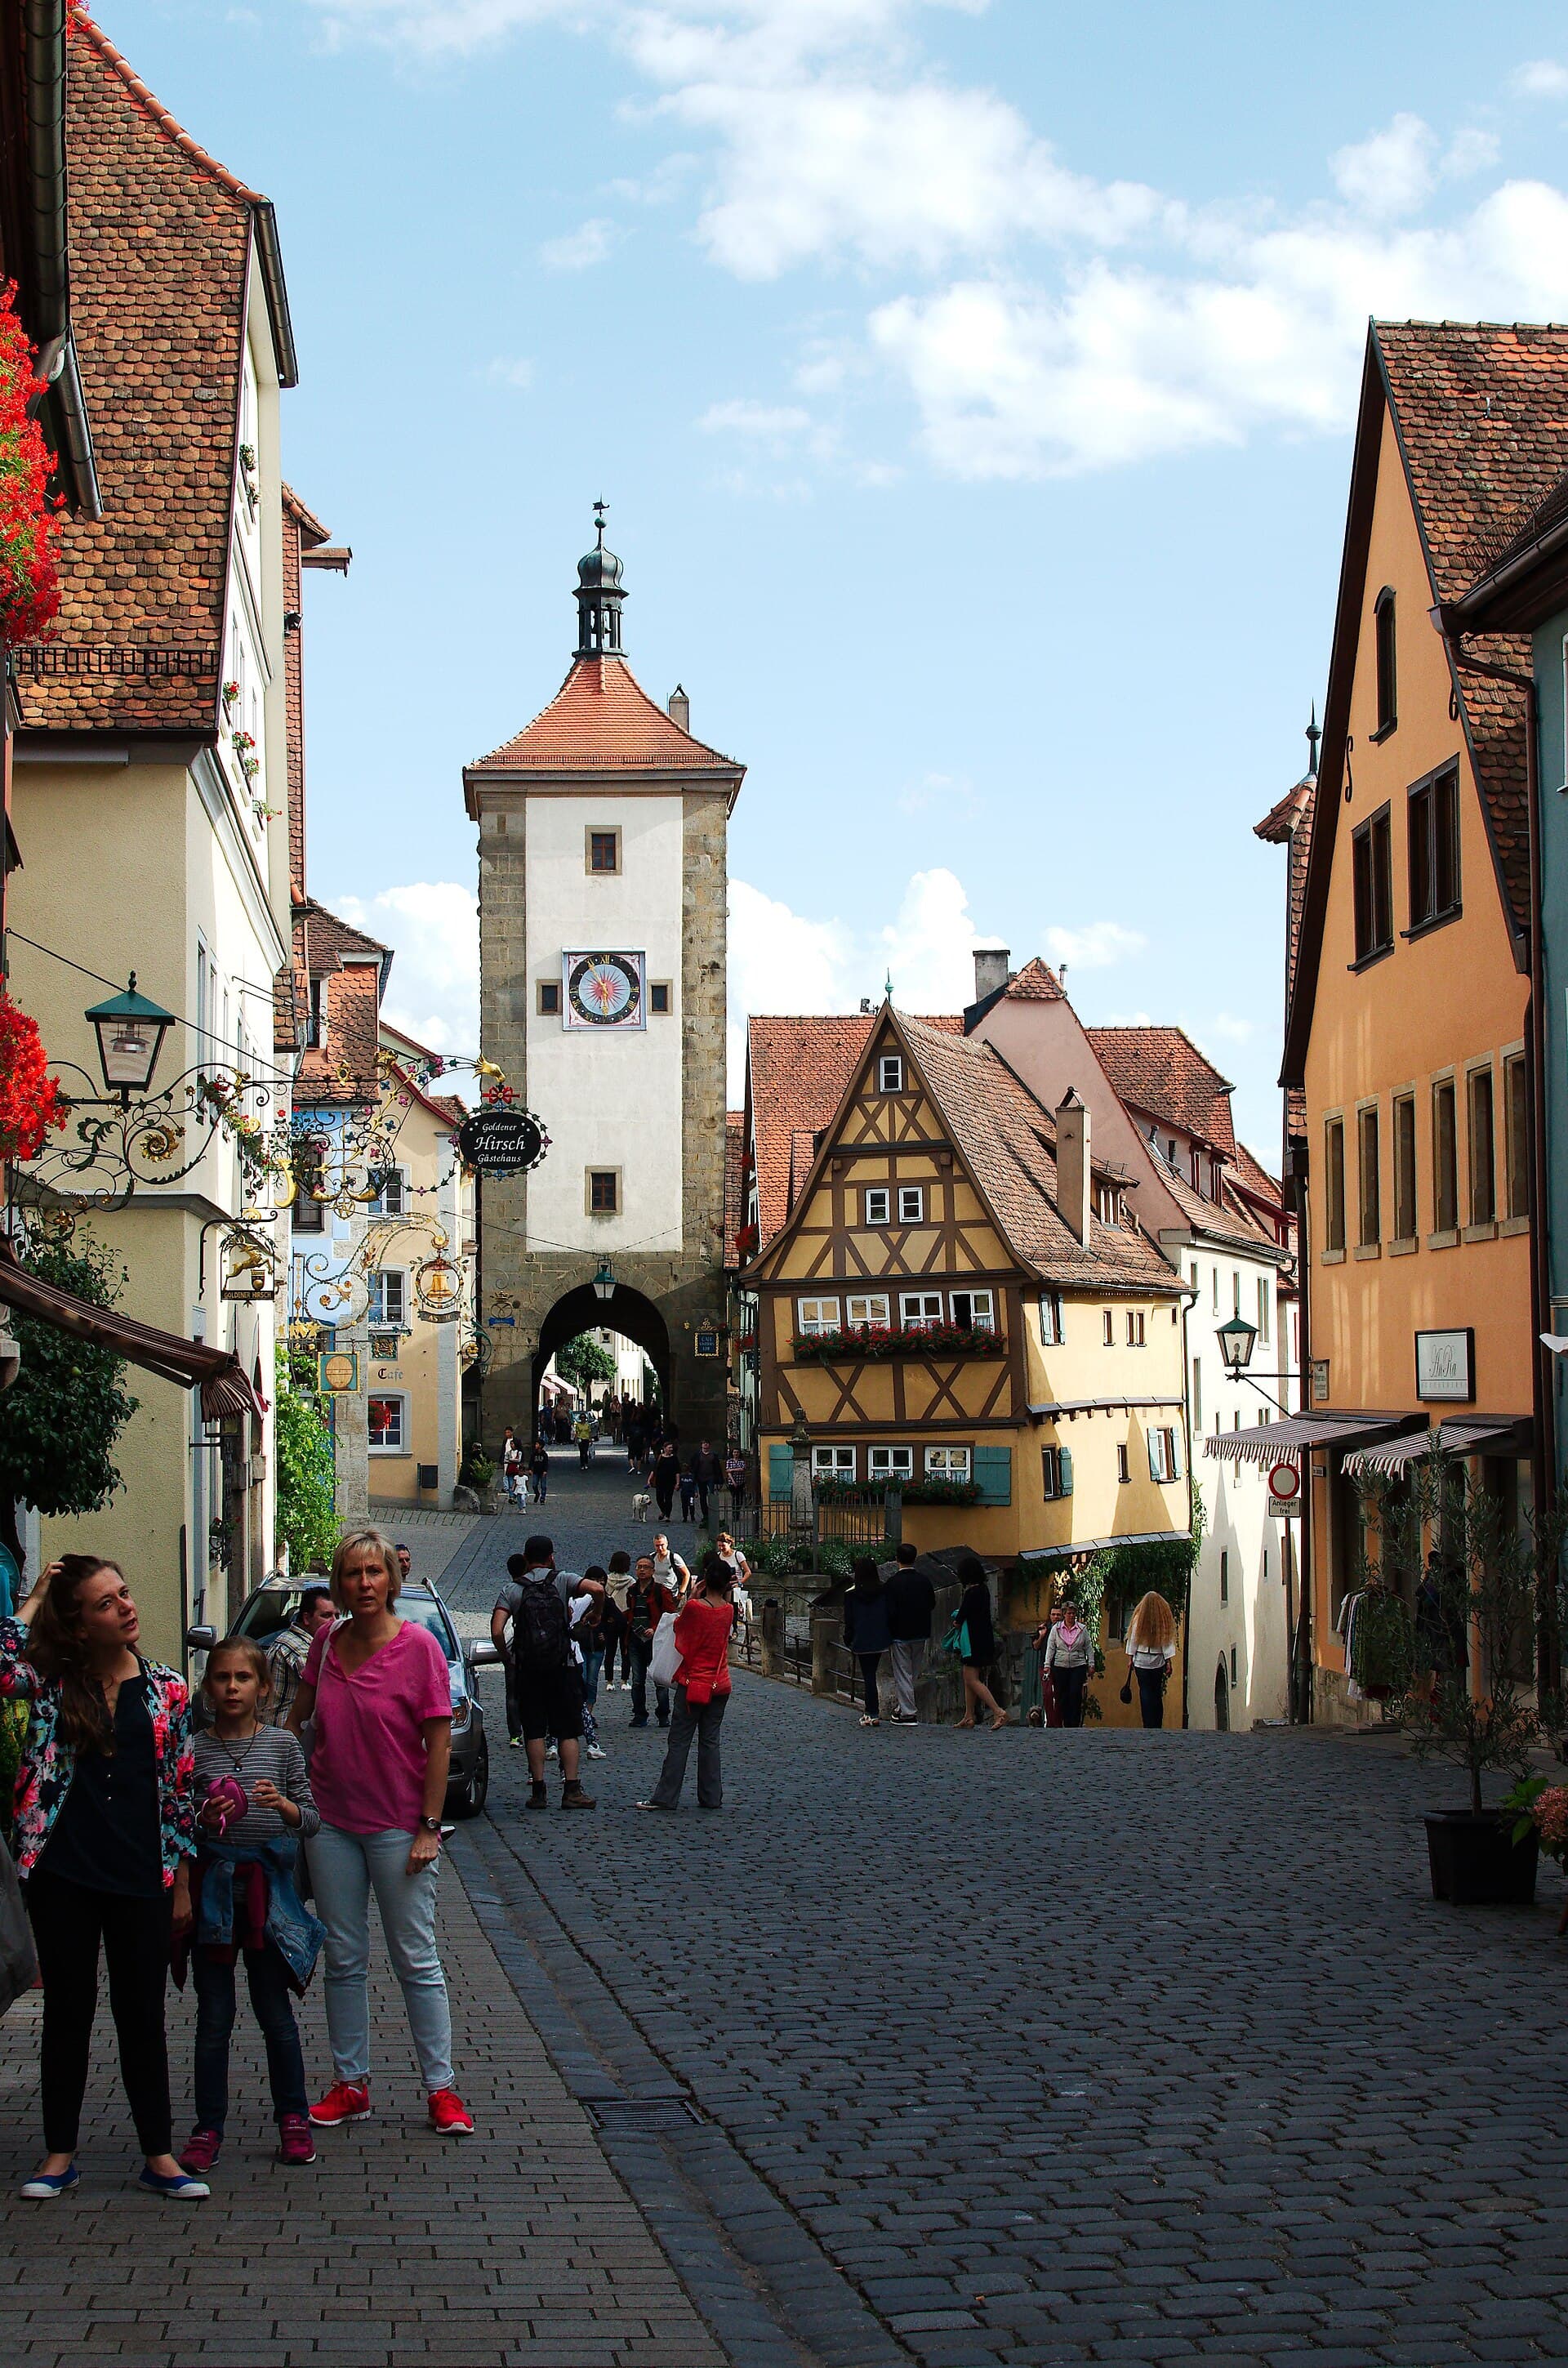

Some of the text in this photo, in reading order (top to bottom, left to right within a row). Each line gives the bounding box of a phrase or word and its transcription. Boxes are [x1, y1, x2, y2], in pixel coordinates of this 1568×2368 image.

[482, 1122, 517, 1132] Goldener
[474, 1135, 525, 1150] Hirsch
[477, 1153, 522, 1164] Gästehaus
[1272, 1499, 1297, 1507] Anlieger
